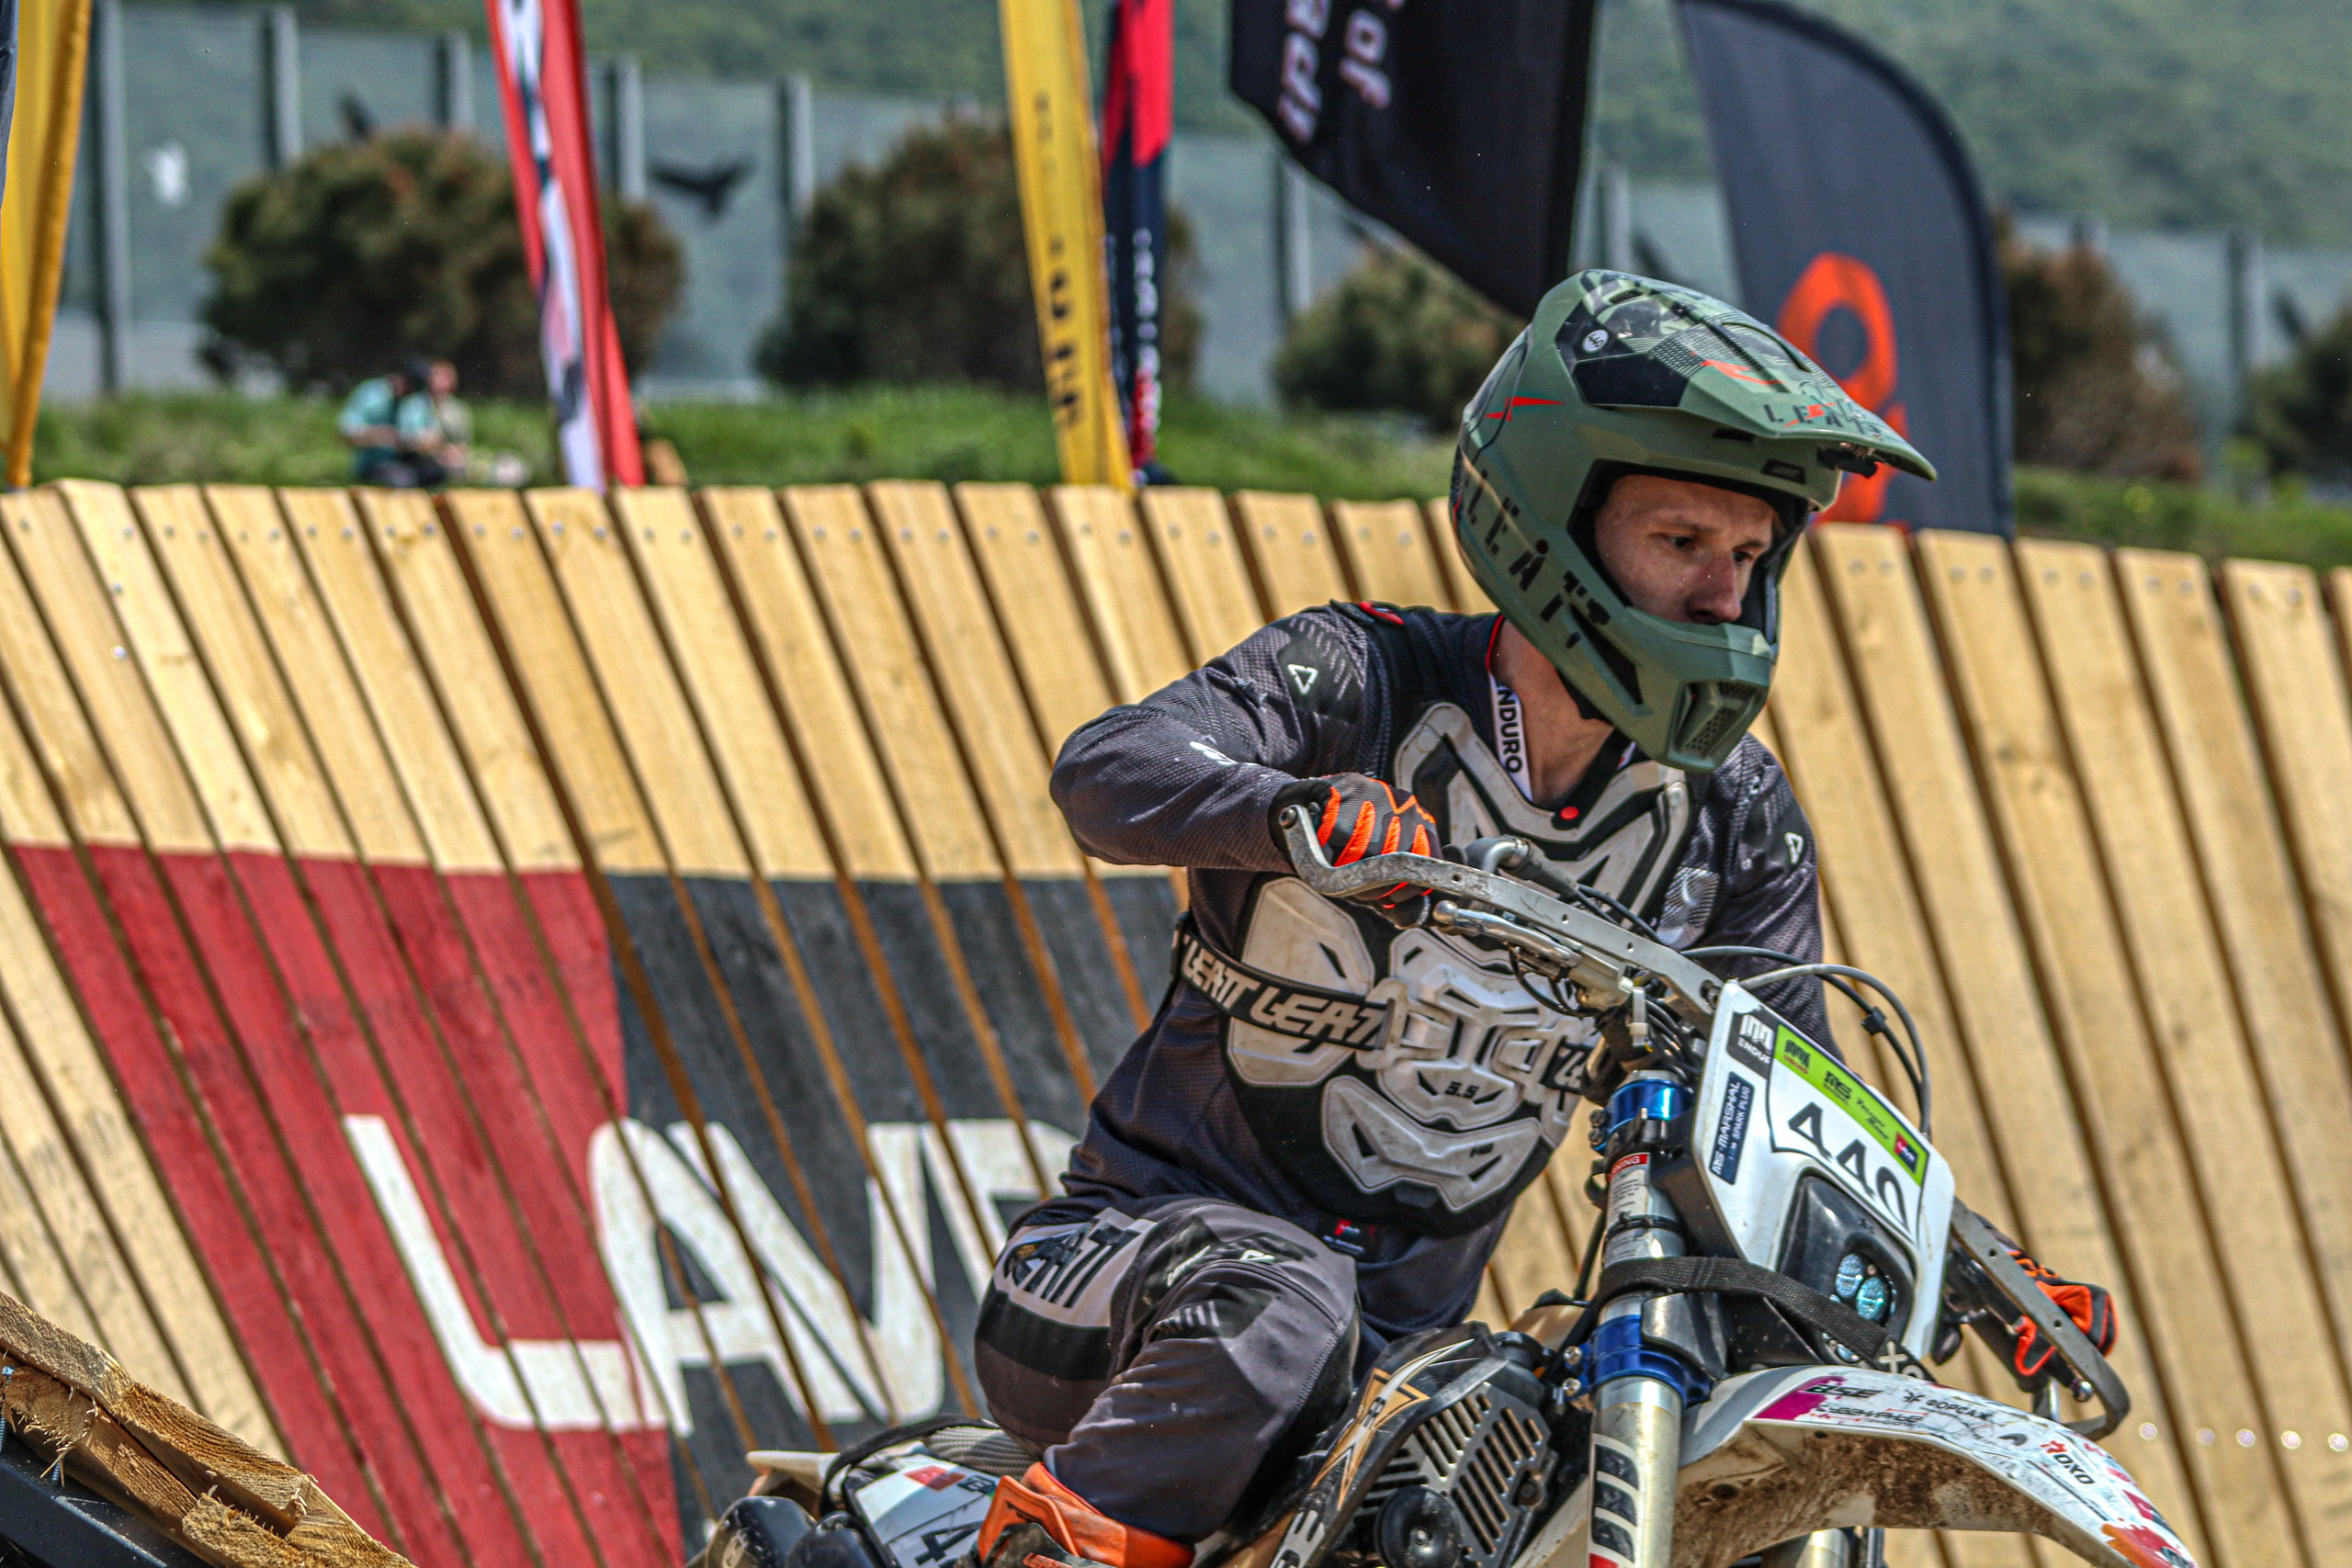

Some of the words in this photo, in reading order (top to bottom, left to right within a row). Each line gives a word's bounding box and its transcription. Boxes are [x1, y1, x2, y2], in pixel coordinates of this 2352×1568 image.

[1497, 685, 1523, 773] NDURO
[1738, 1085, 1750, 1111] PLUG
[1732, 1110, 1746, 1140] SPARK
